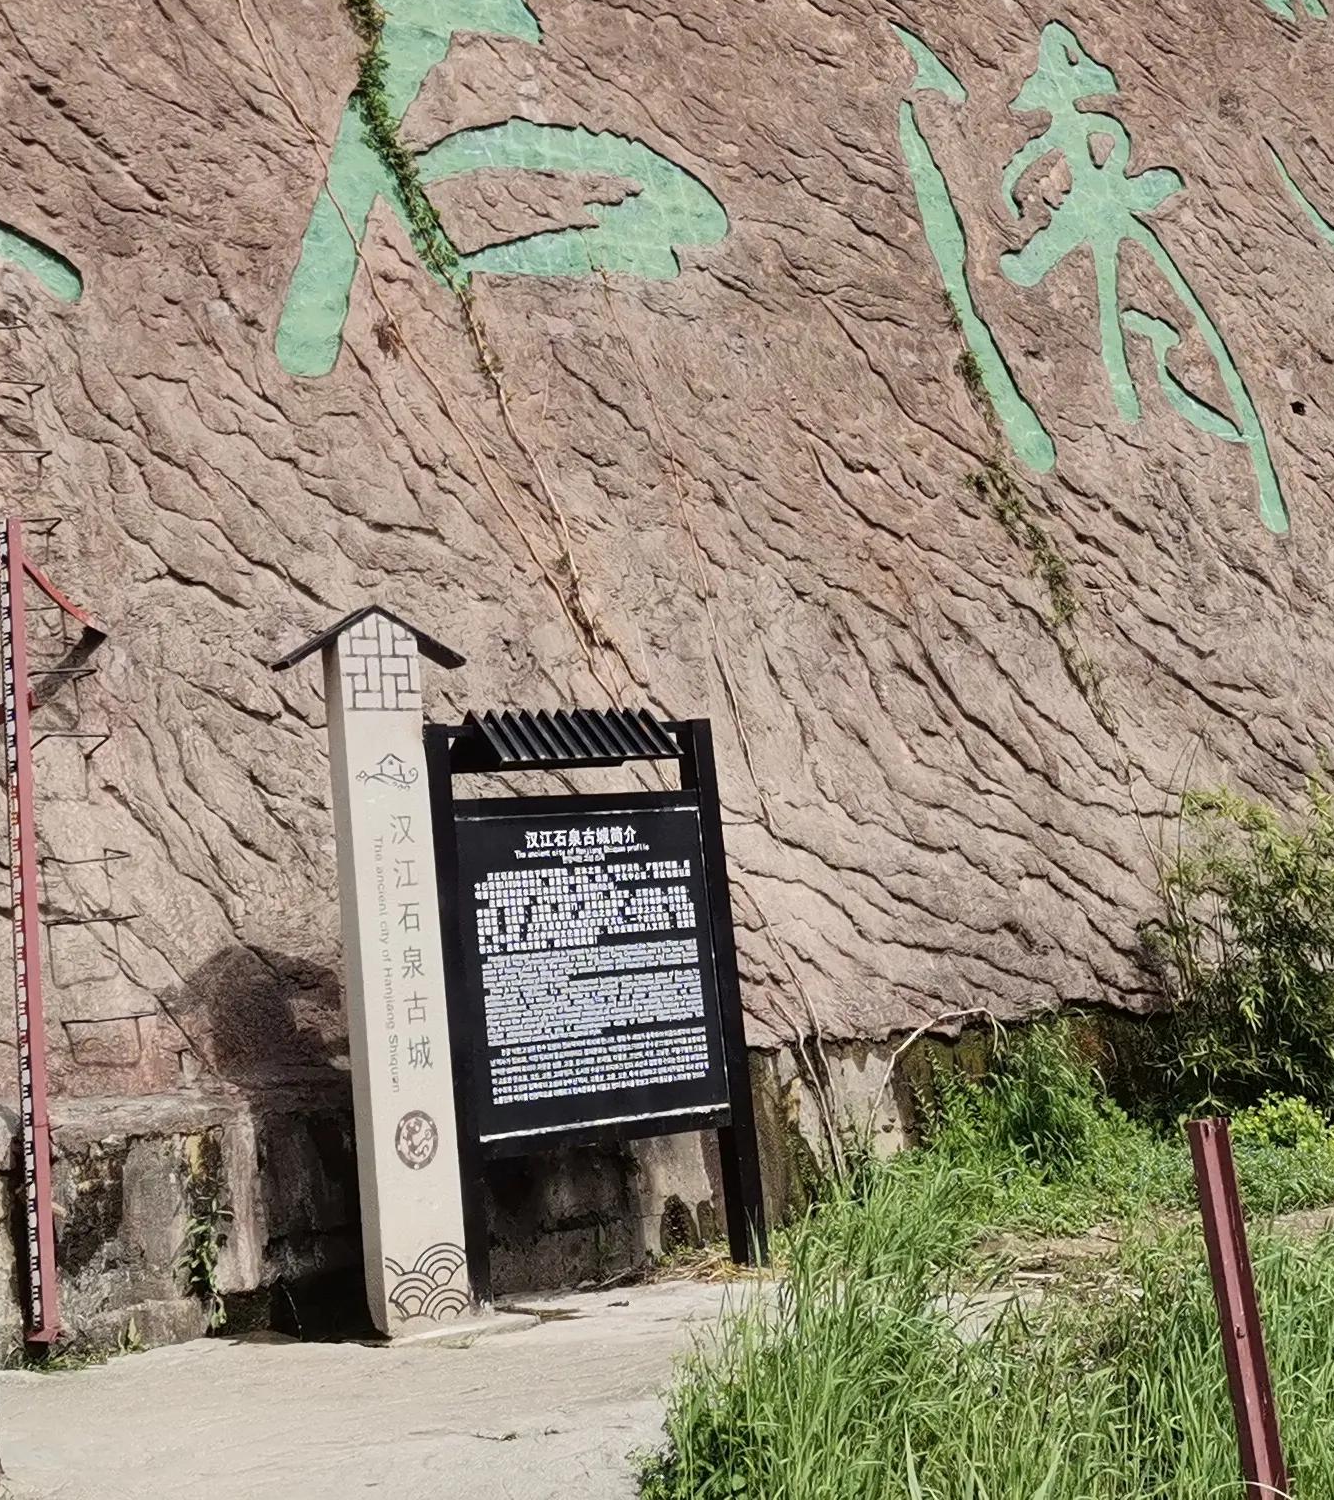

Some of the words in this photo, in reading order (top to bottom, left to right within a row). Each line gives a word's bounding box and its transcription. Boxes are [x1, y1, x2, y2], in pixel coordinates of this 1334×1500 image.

[373, 836, 384, 863] The
[525, 825, 637, 849] 汉江石泉古城简介
[375, 866, 387, 915] ancient
[379, 920, 389, 945] city
[389, 813, 434, 1070] 汉江石泉古城
[381, 948, 393, 964] of
[382, 967, 396, 1030] Hanjiang
